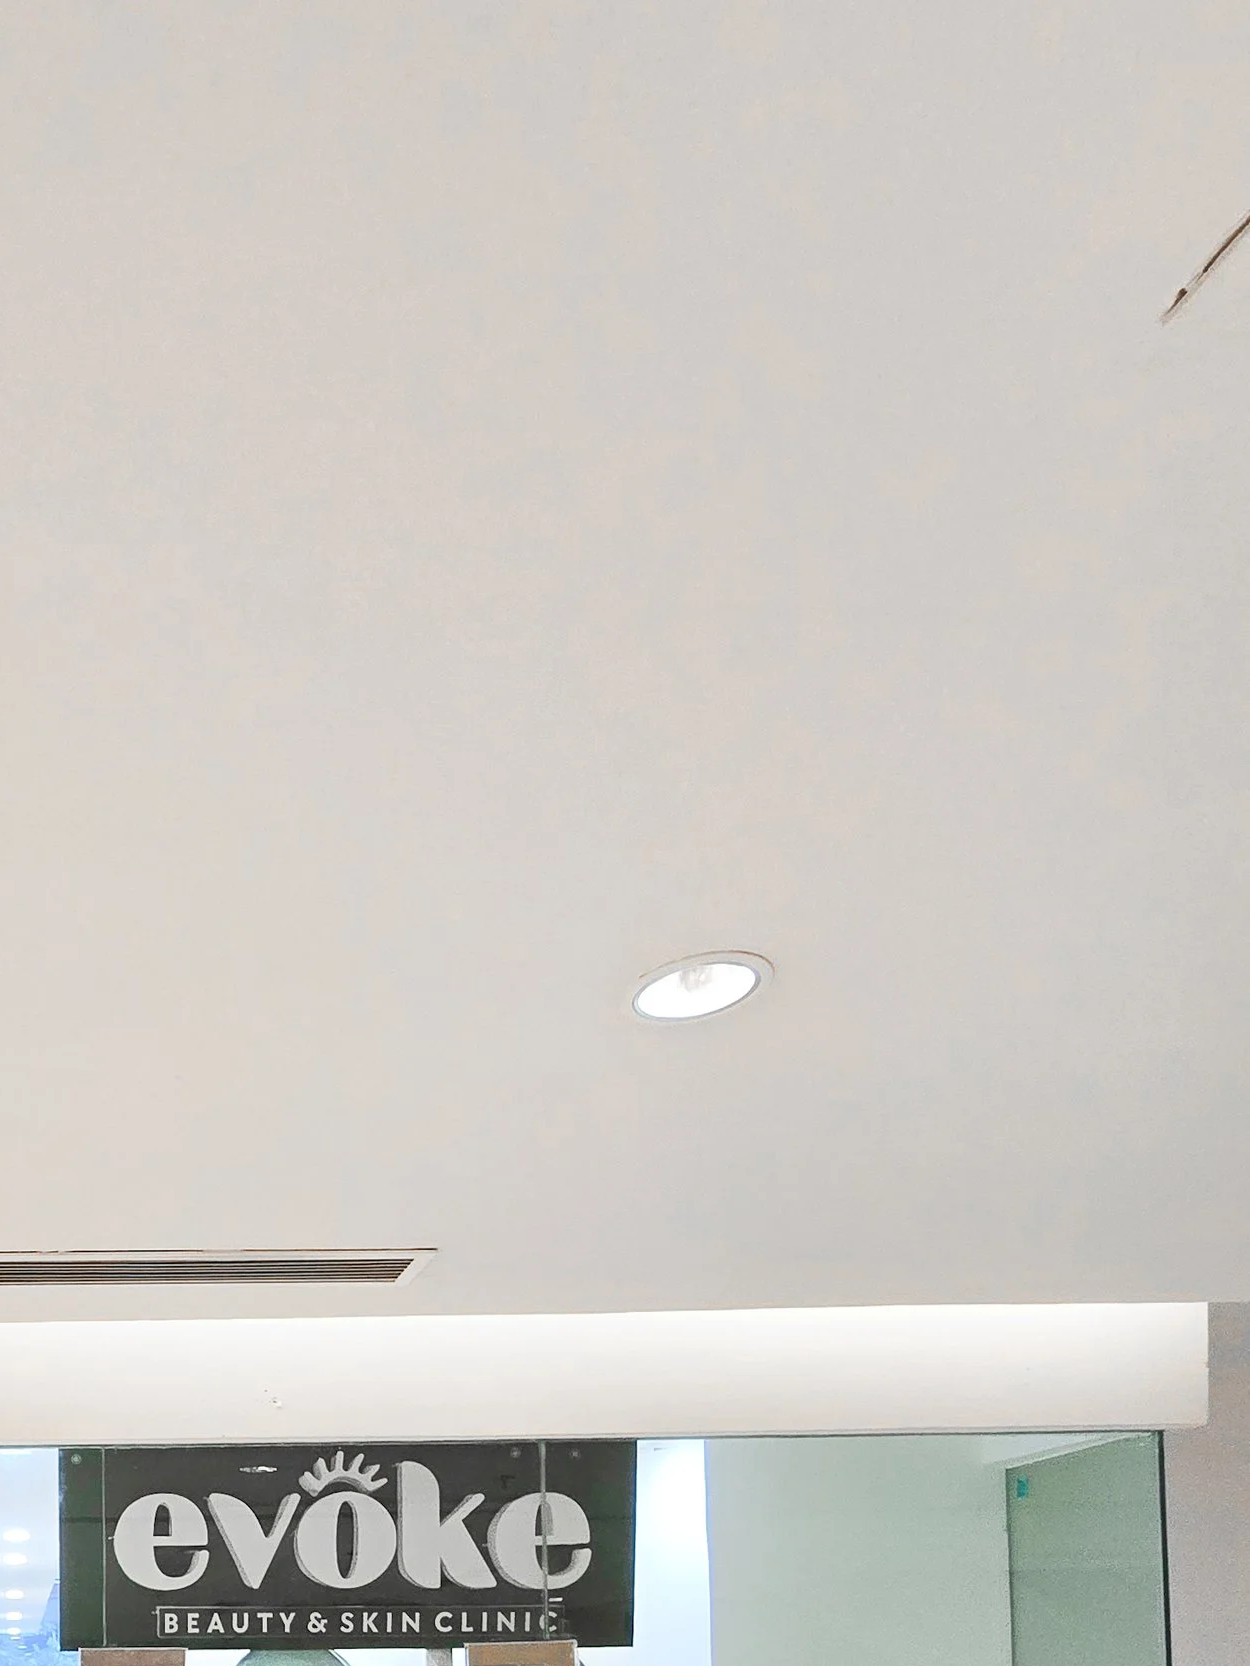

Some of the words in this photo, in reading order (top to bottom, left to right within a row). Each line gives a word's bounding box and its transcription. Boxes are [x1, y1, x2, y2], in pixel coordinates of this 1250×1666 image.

[112, 1458, 593, 1591] evoke
[164, 1612, 295, 1634] BEAUTY
[307, 1612, 328, 1634] &
[338, 1611, 421, 1634] SKIN
[433, 1610, 558, 1633] CLINIC
